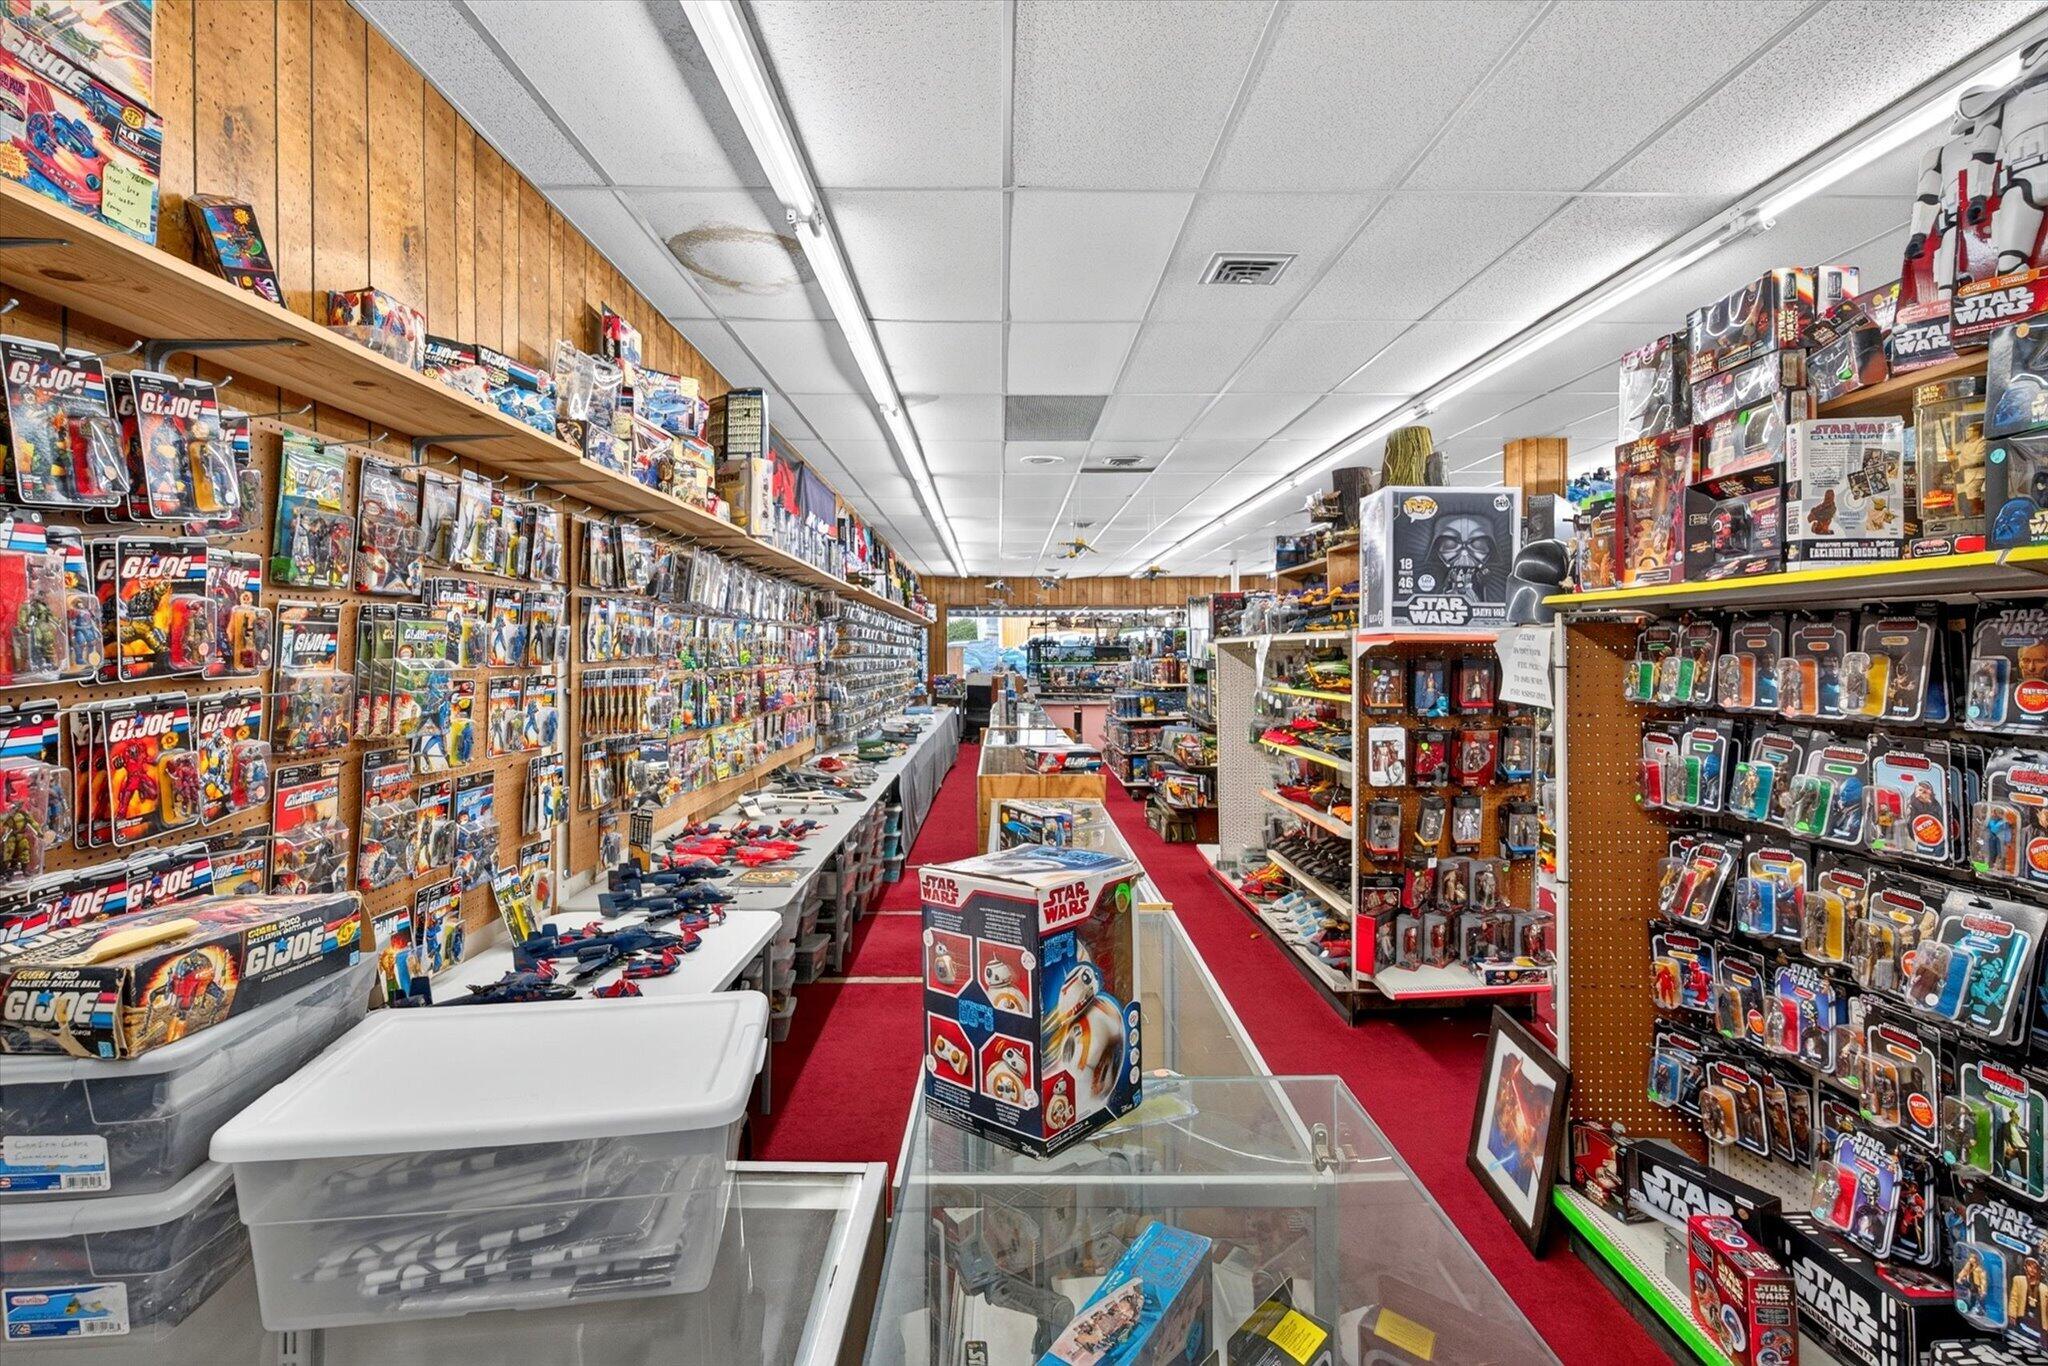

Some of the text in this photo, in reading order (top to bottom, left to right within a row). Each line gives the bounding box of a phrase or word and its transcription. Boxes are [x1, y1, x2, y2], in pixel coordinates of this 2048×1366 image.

[1955, 287, 2034, 312] STAR
[1955, 298, 2034, 325] WARS
[1895, 336, 1951, 355] WAR
[1811, 423, 1854, 434] STAR
[1399, 558, 1413, 569] 18
[1398, 577, 1414, 589] 46
[1409, 598, 1468, 610] STAR
[1409, 611, 1469, 624] WARS
[2000, 609, 2047, 621] STAR
[922, 875, 958, 892] STAR
[922, 886, 959, 905] WARS
[1043, 881, 1089, 907] STAR
[1044, 897, 1089, 924] WARS
[1642, 1165, 1735, 1217] STAR
[1642, 1179, 1692, 1225] WA
[1984, 1200, 2038, 1231] STAR
[1755, 1284, 1790, 1293] STAR
[1755, 1292, 1790, 1301] WARS
[1792, 1257, 1878, 1331] STAR
[1793, 1269, 1879, 1348] WARS
